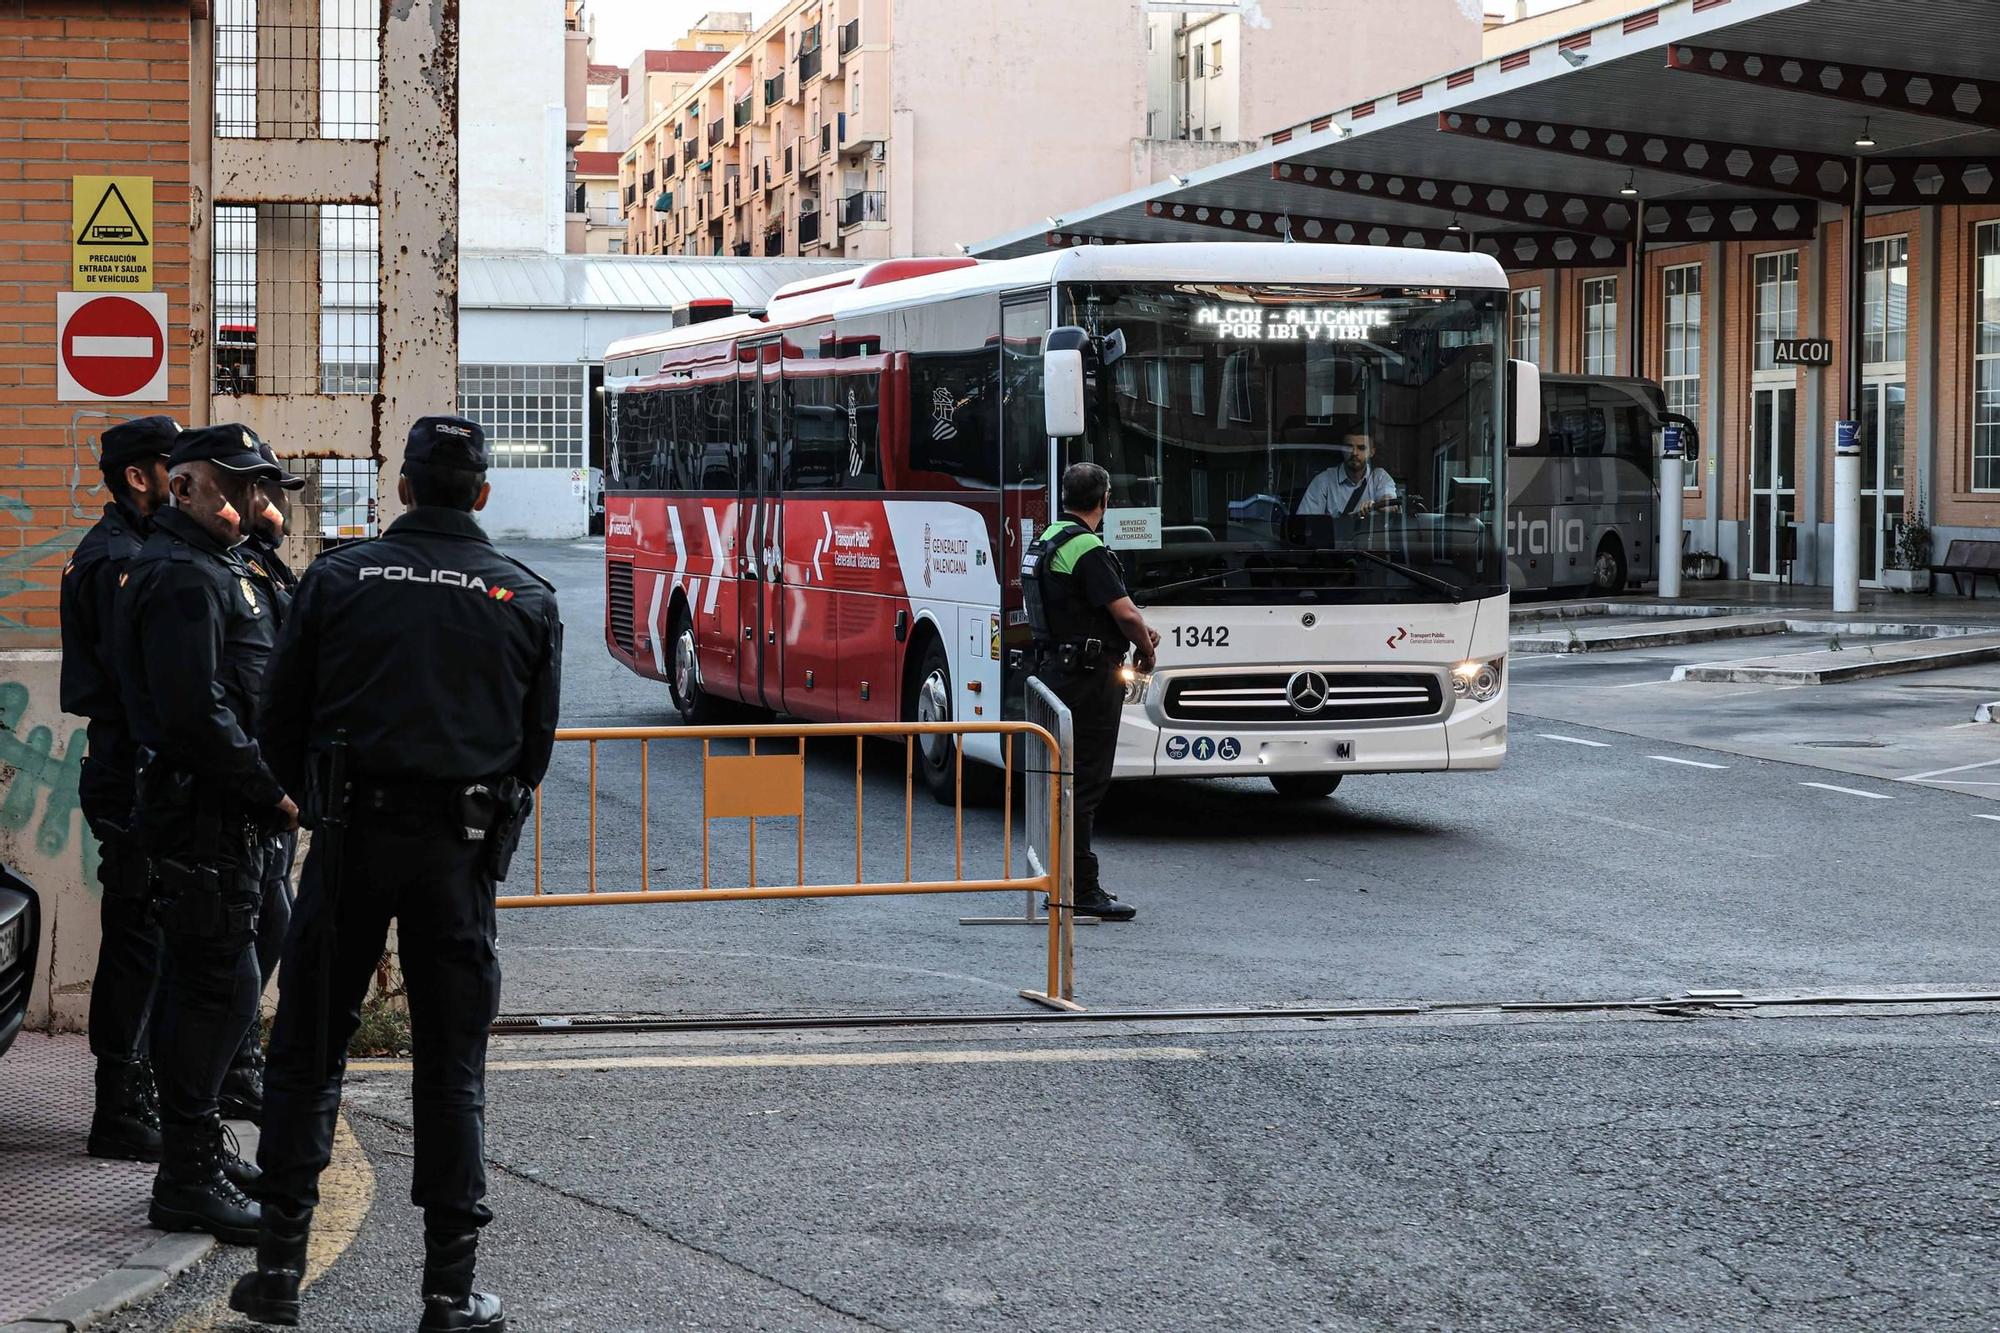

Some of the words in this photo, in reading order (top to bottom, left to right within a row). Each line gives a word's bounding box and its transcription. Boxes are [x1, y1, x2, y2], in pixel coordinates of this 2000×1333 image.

[89, 254, 137, 262] PRECAUCIÓN
[79, 265, 113, 273] ENTRADA
[121, 265, 147, 273] SALIDA
[87, 275, 97, 283] DE
[98, 274, 139, 283] VEHÍCULOS
[1197, 308, 1263, 324] ALCOI
[1286, 308, 1392, 326] ALICANTE
[1219, 324, 1261, 340] POR
[1267, 324, 1299, 339] IBI
[1305, 324, 1321, 340] Y
[1328, 324, 1370, 340] TIBI
[1776, 342, 1829, 361] ALCOI
[1119, 519, 1148, 527] SERVICIO
[835, 530, 855, 549] Transport
[1115, 533, 1153, 541] AUTORIZADO
[932, 538, 968, 555] GENERALITAT
[834, 550, 857, 568] Generalitat
[857, 551, 880, 569] Valenciana
[932, 558, 967, 575] VALENCIANA
[359, 566, 488, 593] POLICIA
[1171, 625, 1230, 648] 1342
